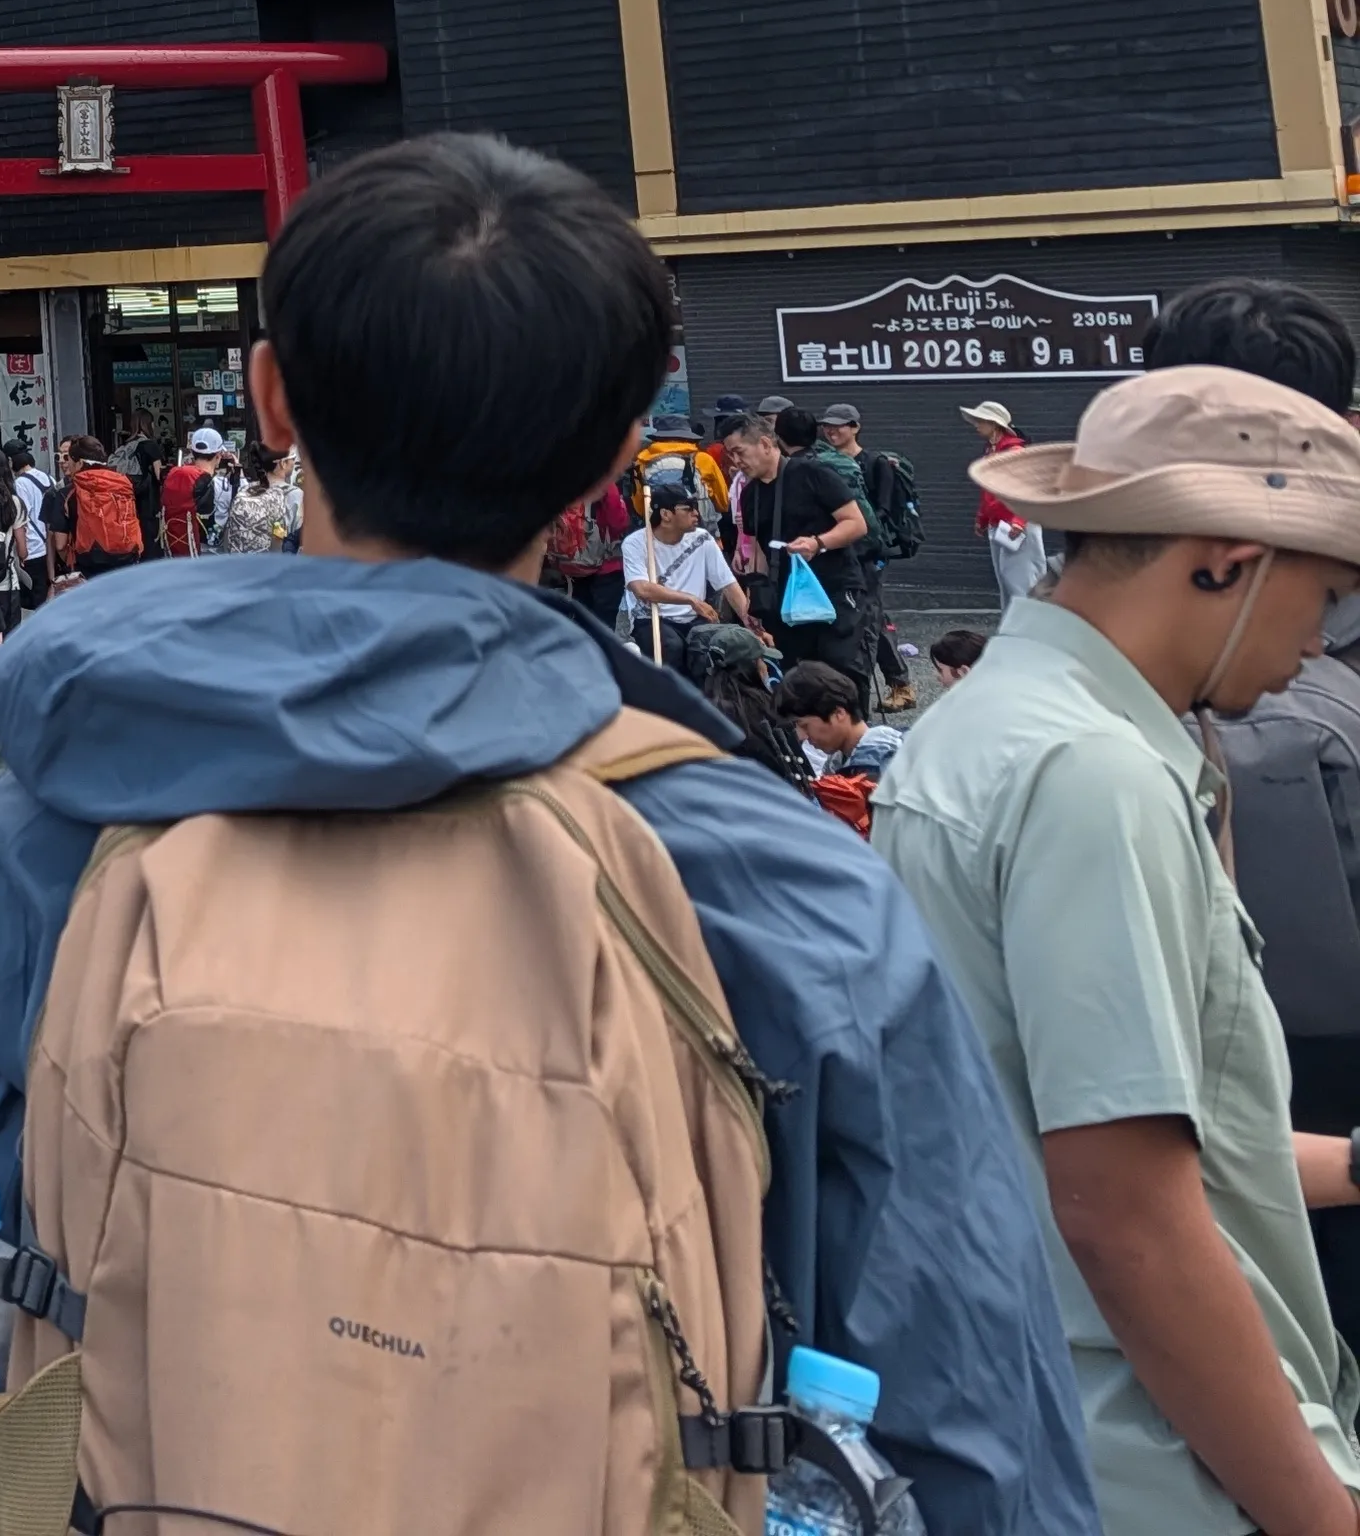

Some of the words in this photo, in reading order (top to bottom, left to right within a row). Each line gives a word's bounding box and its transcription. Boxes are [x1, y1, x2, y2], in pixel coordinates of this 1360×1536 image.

[797, 340, 892, 372] 富士山
[328, 1316, 426, 1360] QUECHUA
